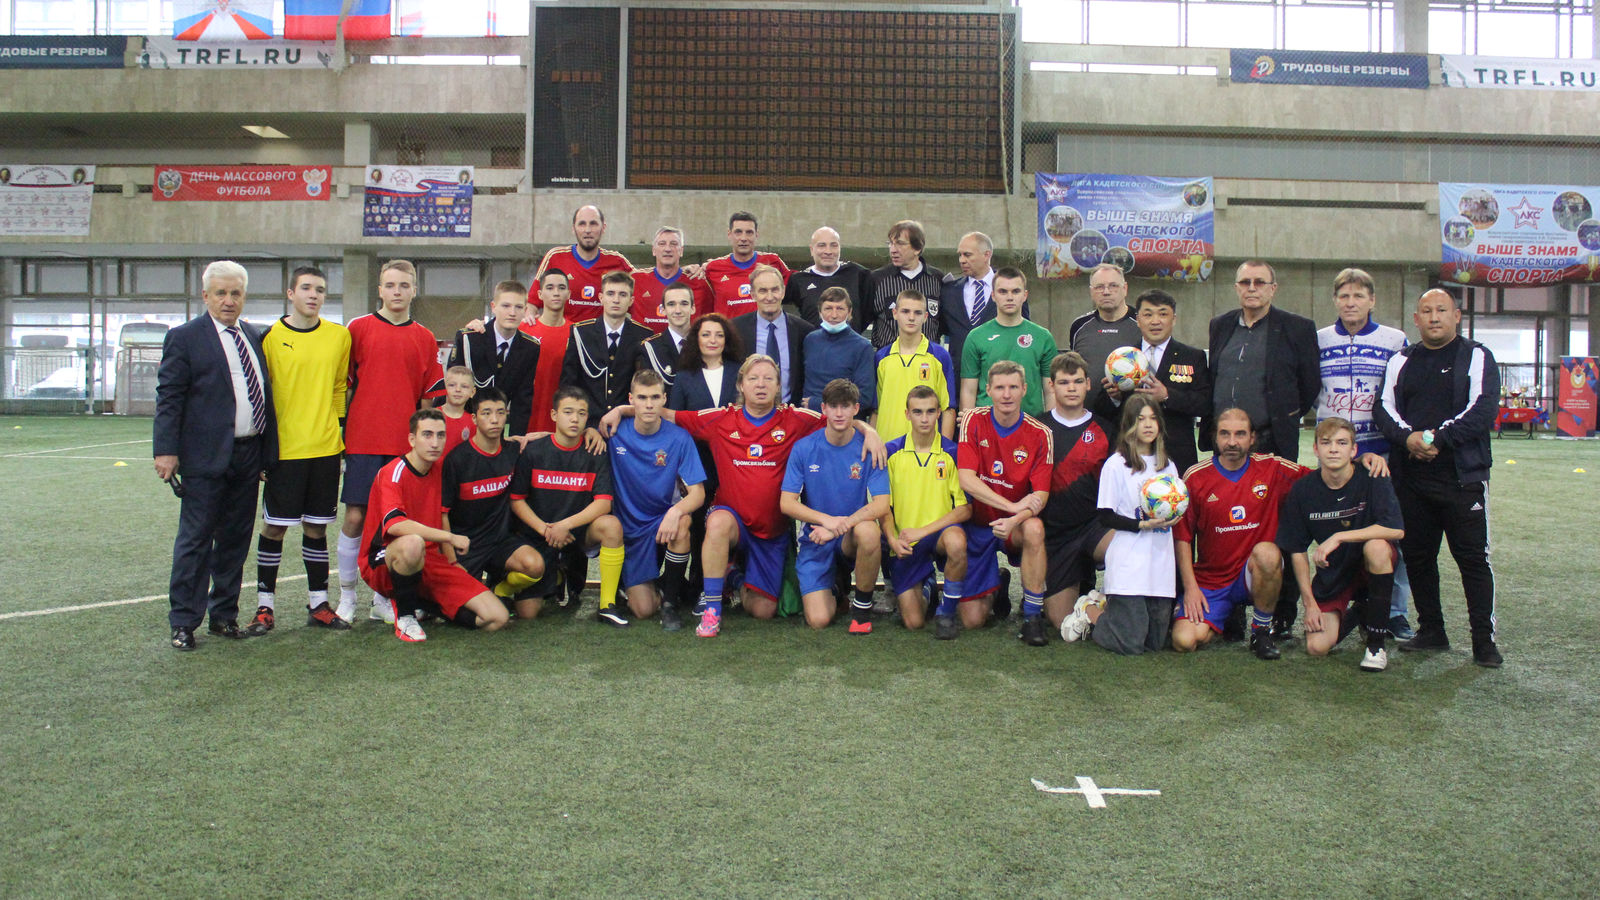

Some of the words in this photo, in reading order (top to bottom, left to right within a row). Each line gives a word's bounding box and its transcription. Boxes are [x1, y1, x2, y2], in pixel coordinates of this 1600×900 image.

[0, 47, 48, 57] ДОВЫЕ
[50, 47, 108, 56] РЕЗЕРВЫ
[177, 48, 302, 65] TRFL.RU
[1281, 63, 1350, 74] ТРУДОВЫЕ
[1353, 66, 1410, 76] РЕЗЕРВЫ
[1474, 68, 1597, 88] TRFL.RU
[189, 171, 220, 183] ДЕНЬ
[223, 171, 296, 182] МАССОВОГО
[216, 186, 271, 196] ФУТБОЛА
[1087, 210, 1136, 221] ВЫШЕ
[1140, 211, 1194, 224] ЗНАМЯ
[1520, 211, 1541, 220] ЛКС
[1107, 224, 1195, 236] КАДЕТСКОГО
[1127, 238, 1205, 255] СПОРТА
[1476, 245, 1523, 255] ВЫШЕ
[1528, 245, 1578, 256] ЗНАМЯ
[1491, 258, 1565, 267] КАДЕТСКОГО
[1487, 269, 1564, 284] СПОРТА
[537, 474, 588, 486] БАШАНТА
